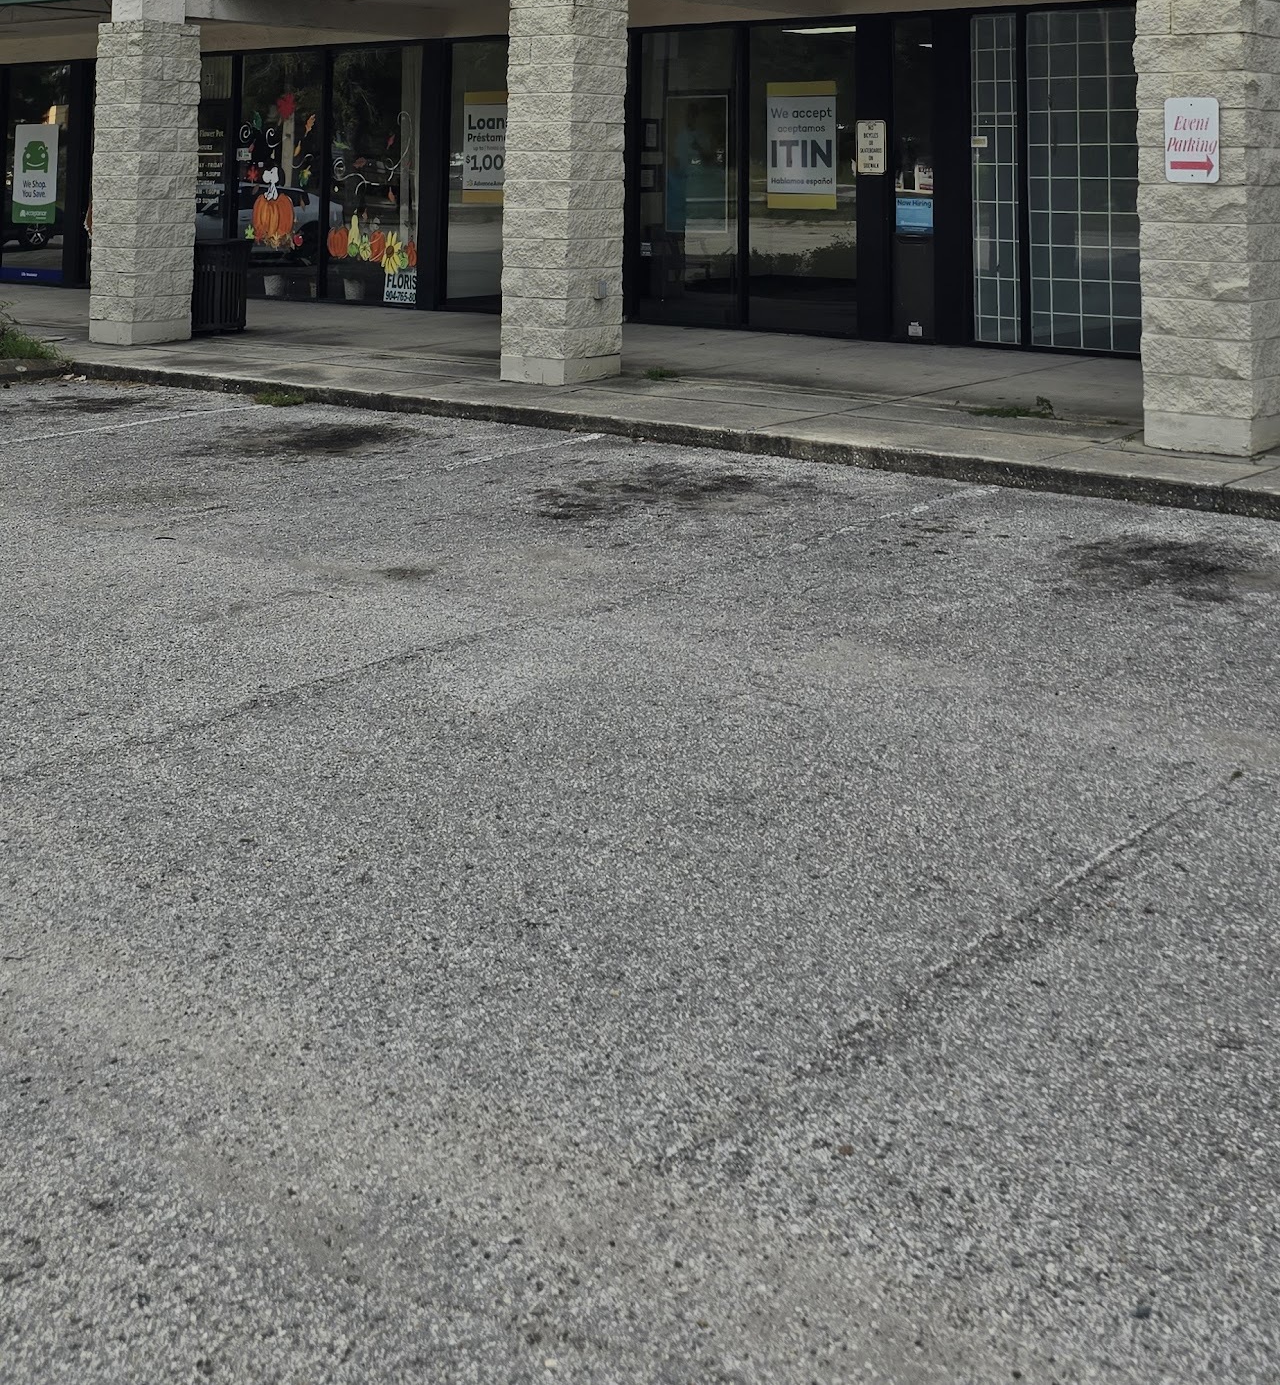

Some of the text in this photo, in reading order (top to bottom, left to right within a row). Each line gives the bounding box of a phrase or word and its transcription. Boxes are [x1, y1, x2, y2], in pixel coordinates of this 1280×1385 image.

[771, 107, 833, 121] We accept
[1174, 115, 1210, 131] Event
[777, 124, 826, 135] aceptamos
[1167, 137, 1218, 155] Parking
[771, 139, 832, 168] ITIN
[23, 180, 47, 190] We Shop.
[771, 177, 833, 186] Hablamos español
[22, 190, 47, 198] You Save.
[912, 199, 932, 209] Hiring
